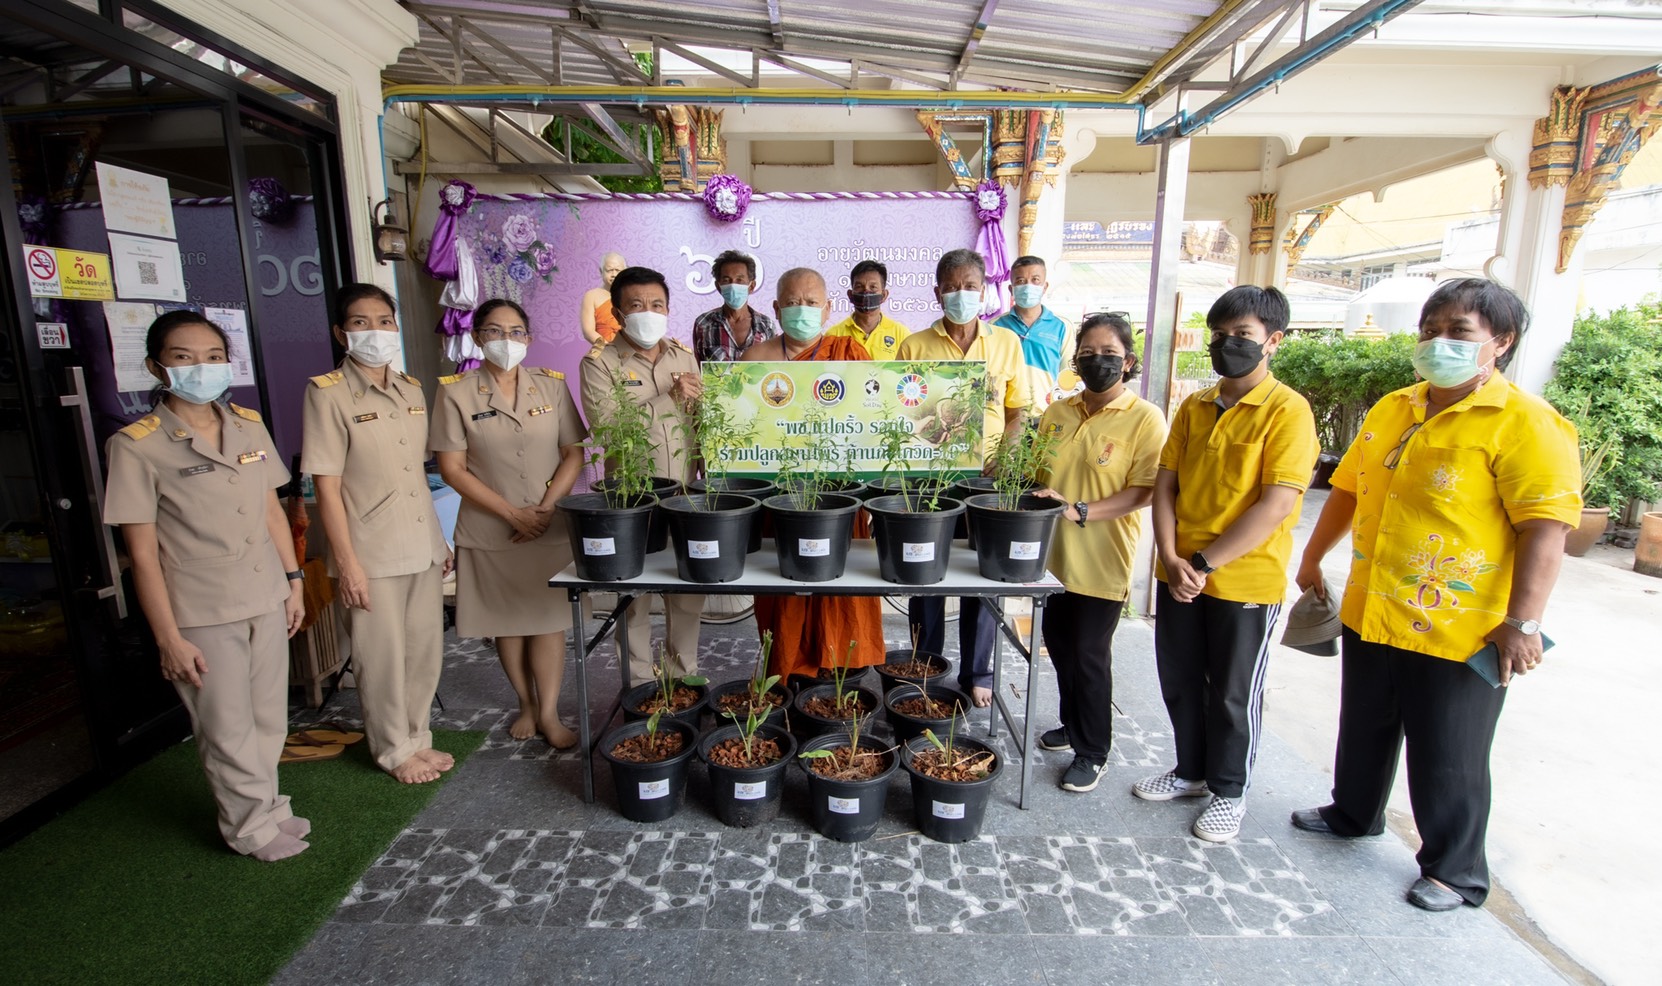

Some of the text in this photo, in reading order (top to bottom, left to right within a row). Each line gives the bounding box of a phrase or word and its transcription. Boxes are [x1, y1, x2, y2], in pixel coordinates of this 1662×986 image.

[744, 216, 761, 248] ปี
[74, 256, 97, 278] วัด
[818, 240, 943, 269] อายุวัฒนมงคล
[42, 336, 61, 345] ขวา
